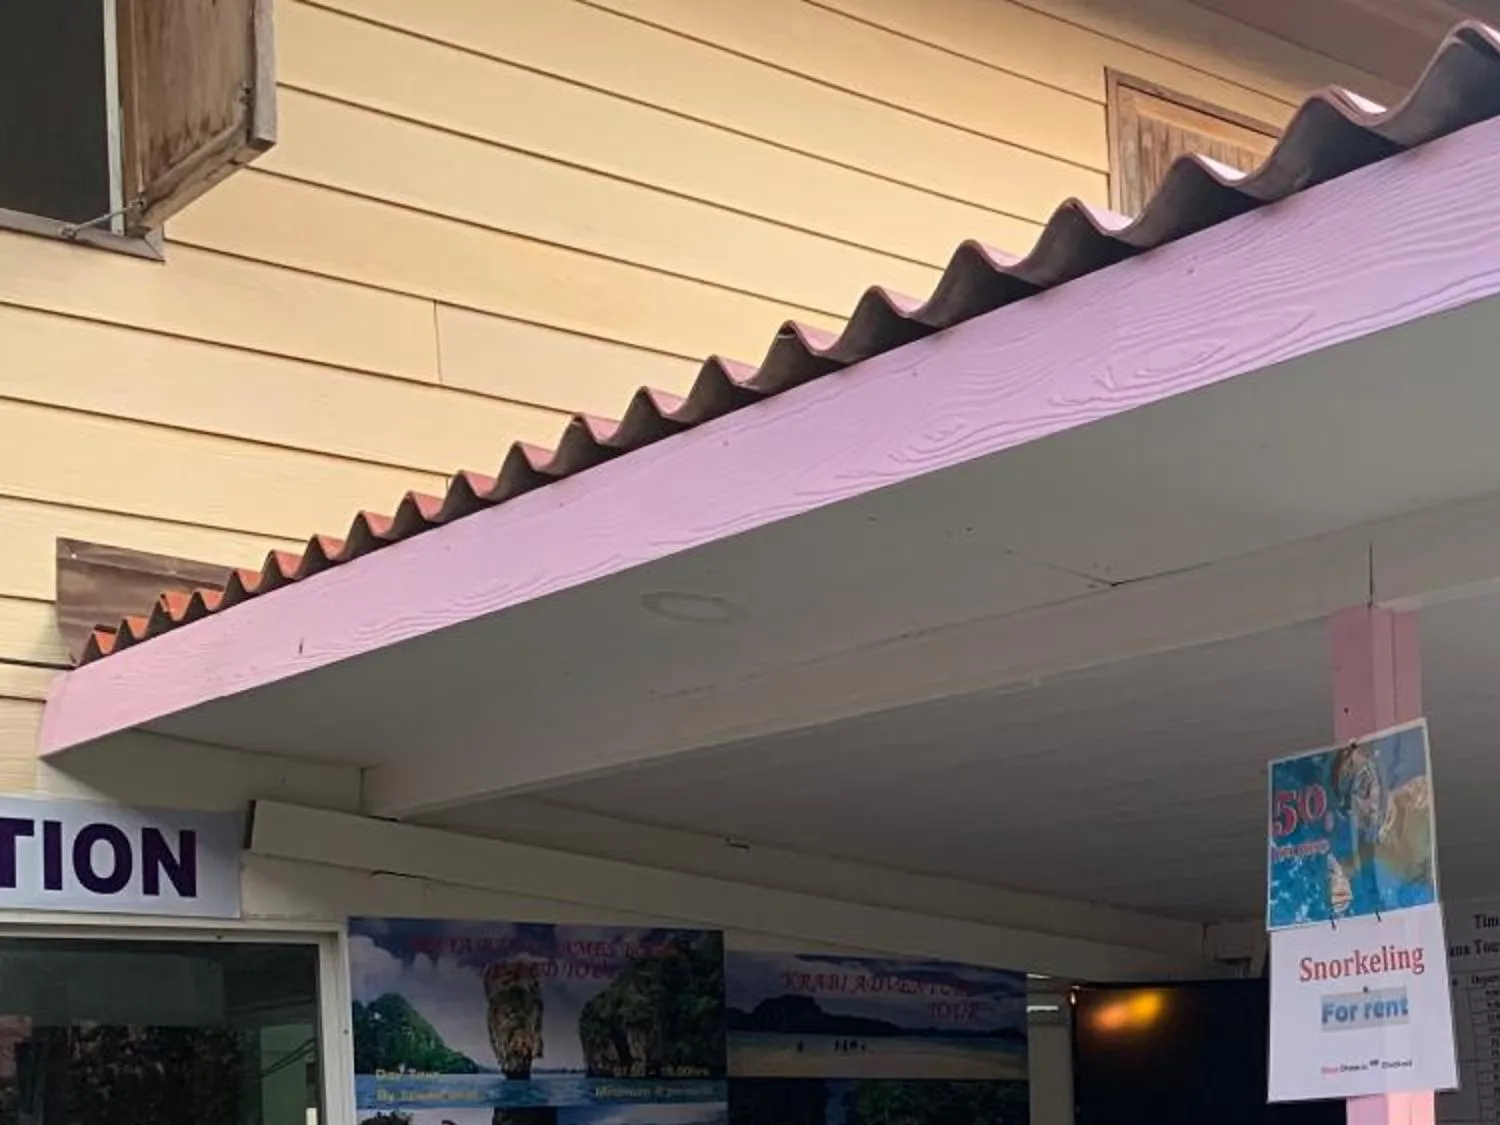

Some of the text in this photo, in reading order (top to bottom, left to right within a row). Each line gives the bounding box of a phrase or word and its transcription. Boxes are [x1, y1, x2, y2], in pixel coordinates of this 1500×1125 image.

[0, 817, 197, 898] TION
[1299, 945, 1425, 982] Snorkeling
[1321, 997, 1409, 1025] For rent
